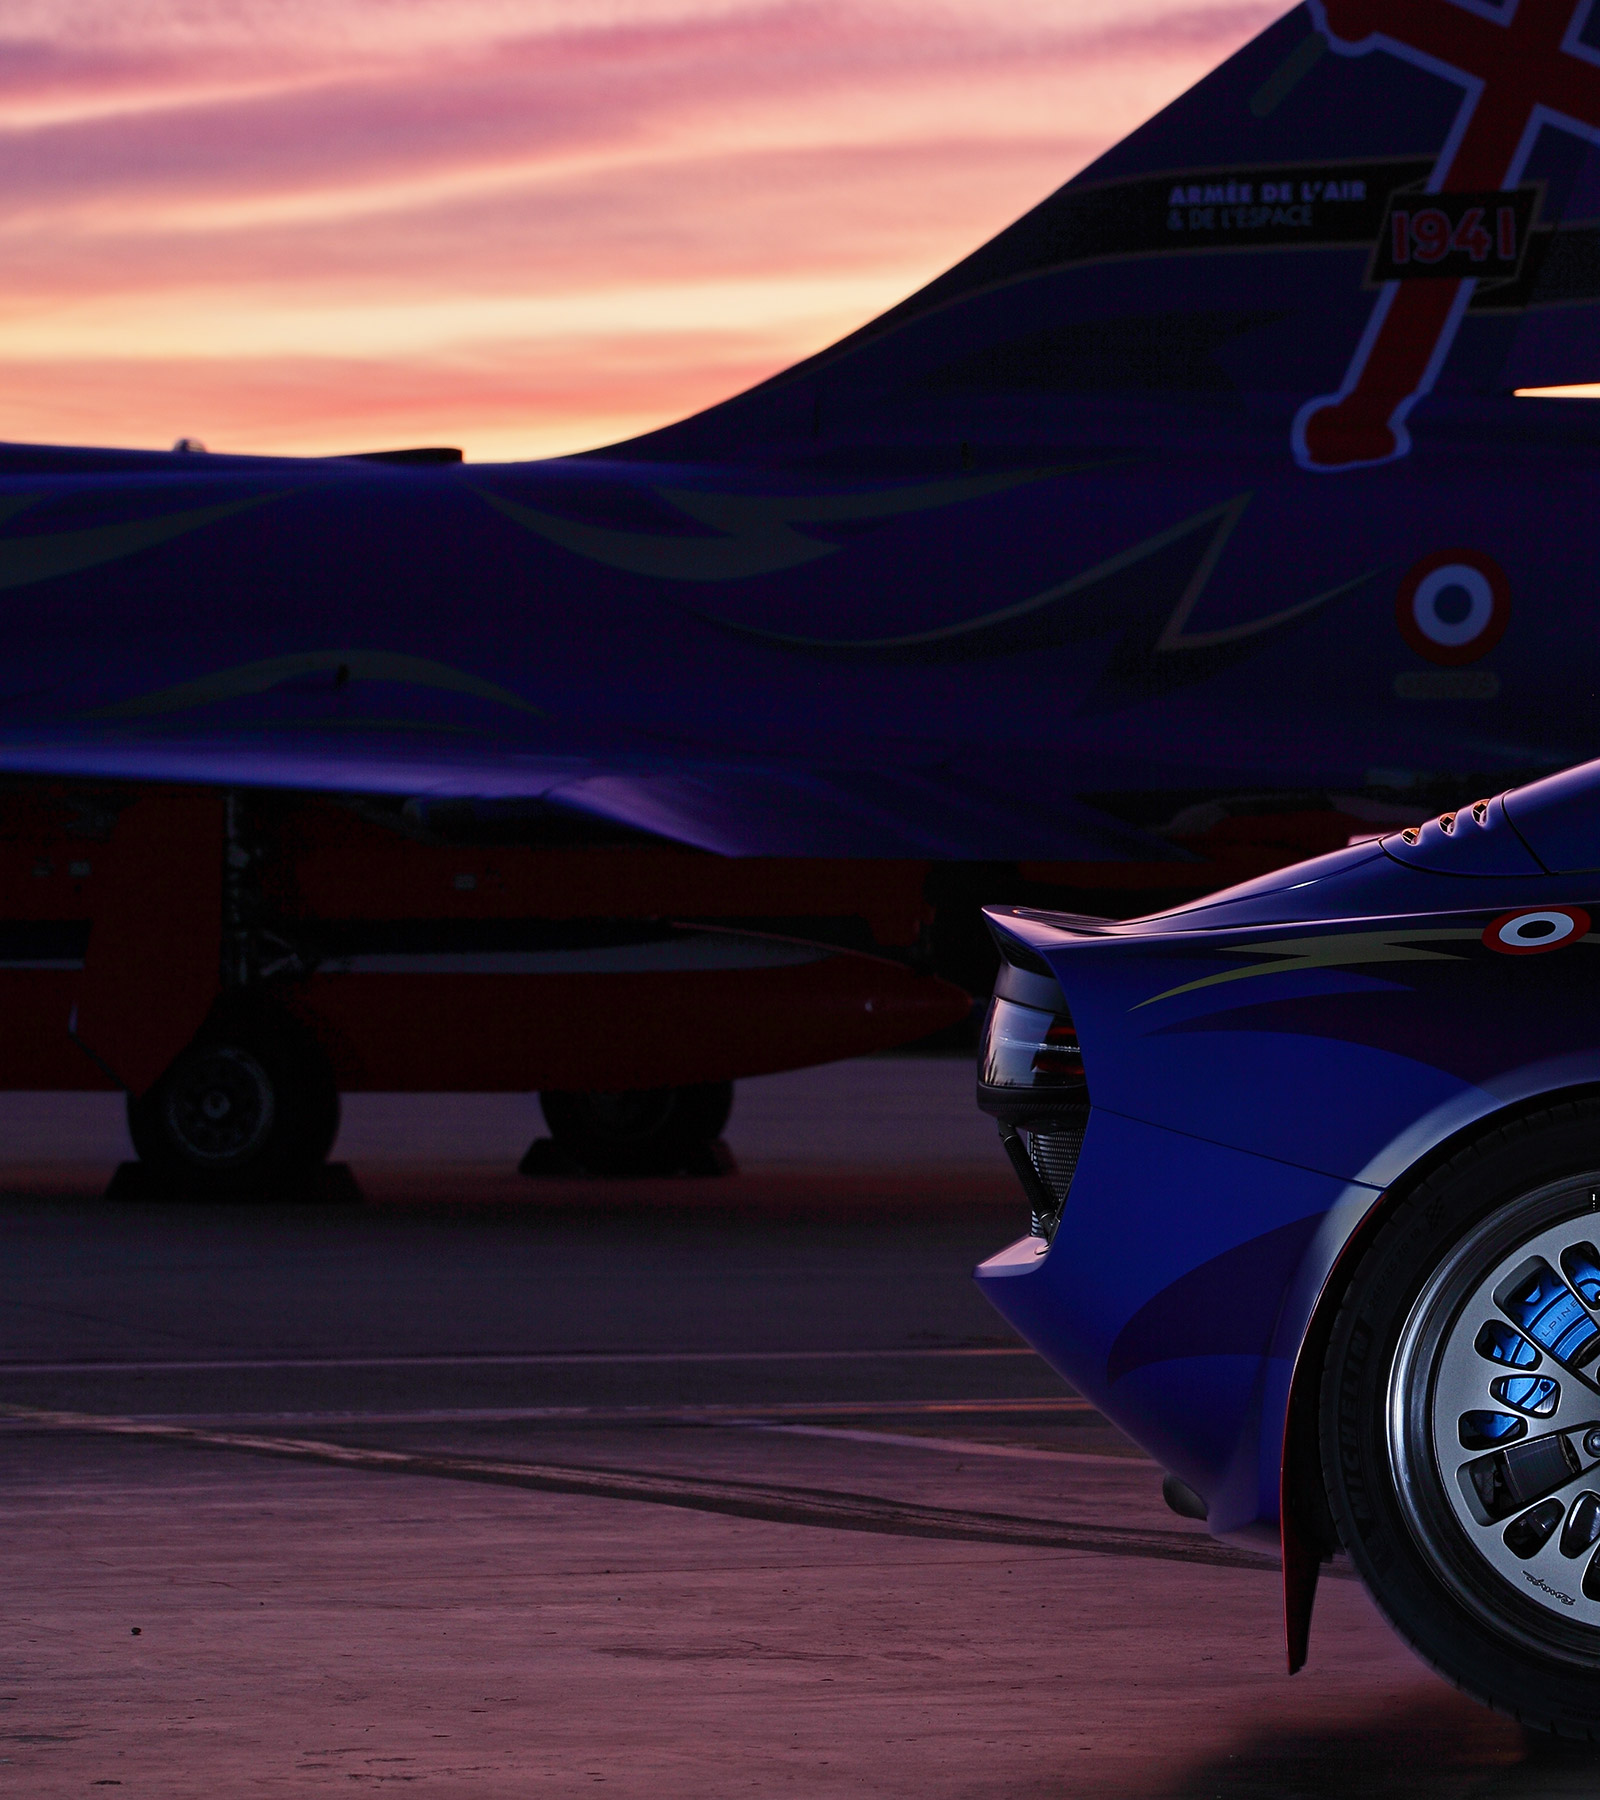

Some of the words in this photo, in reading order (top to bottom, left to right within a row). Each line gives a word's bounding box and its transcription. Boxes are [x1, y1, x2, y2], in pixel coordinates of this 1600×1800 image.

[1168, 179, 1254, 206] ARMÉE
[1260, 180, 1294, 204] DE
[1301, 179, 1367, 203] L'AIR
[1189, 207, 1216, 231] DE
[1220, 204, 1313, 230] L'ESPACE
[1391, 206, 1518, 265] 1941
[1541, 1300, 1578, 1337] LPINE
